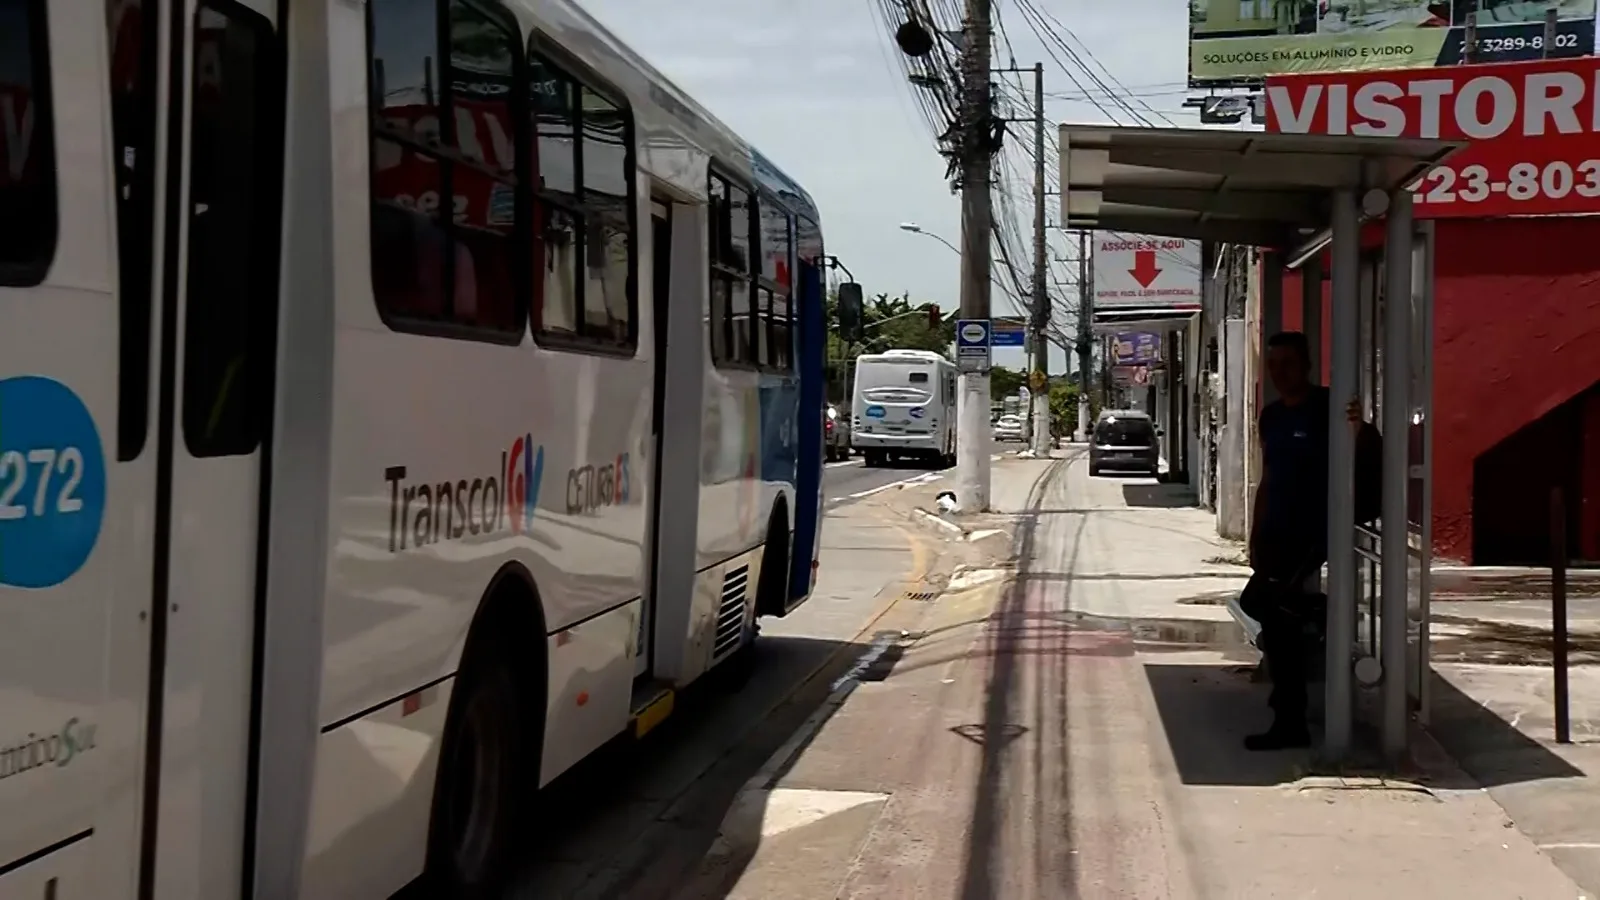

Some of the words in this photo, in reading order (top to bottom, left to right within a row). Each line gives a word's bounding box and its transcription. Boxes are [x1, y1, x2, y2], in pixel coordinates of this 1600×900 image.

[1483, 34, 1578, 52] 3289-802
[1203, 52, 1269, 64] SOLUÇÕES
[1272, 51, 1291, 60] EM
[1293, 47, 1357, 60] ALUMÍNIO
[1361, 47, 1368, 57] E
[1372, 45, 1414, 56] VIDRO
[1161, 239, 1185, 249] AQUI
[385, 451, 507, 553] Transcol
